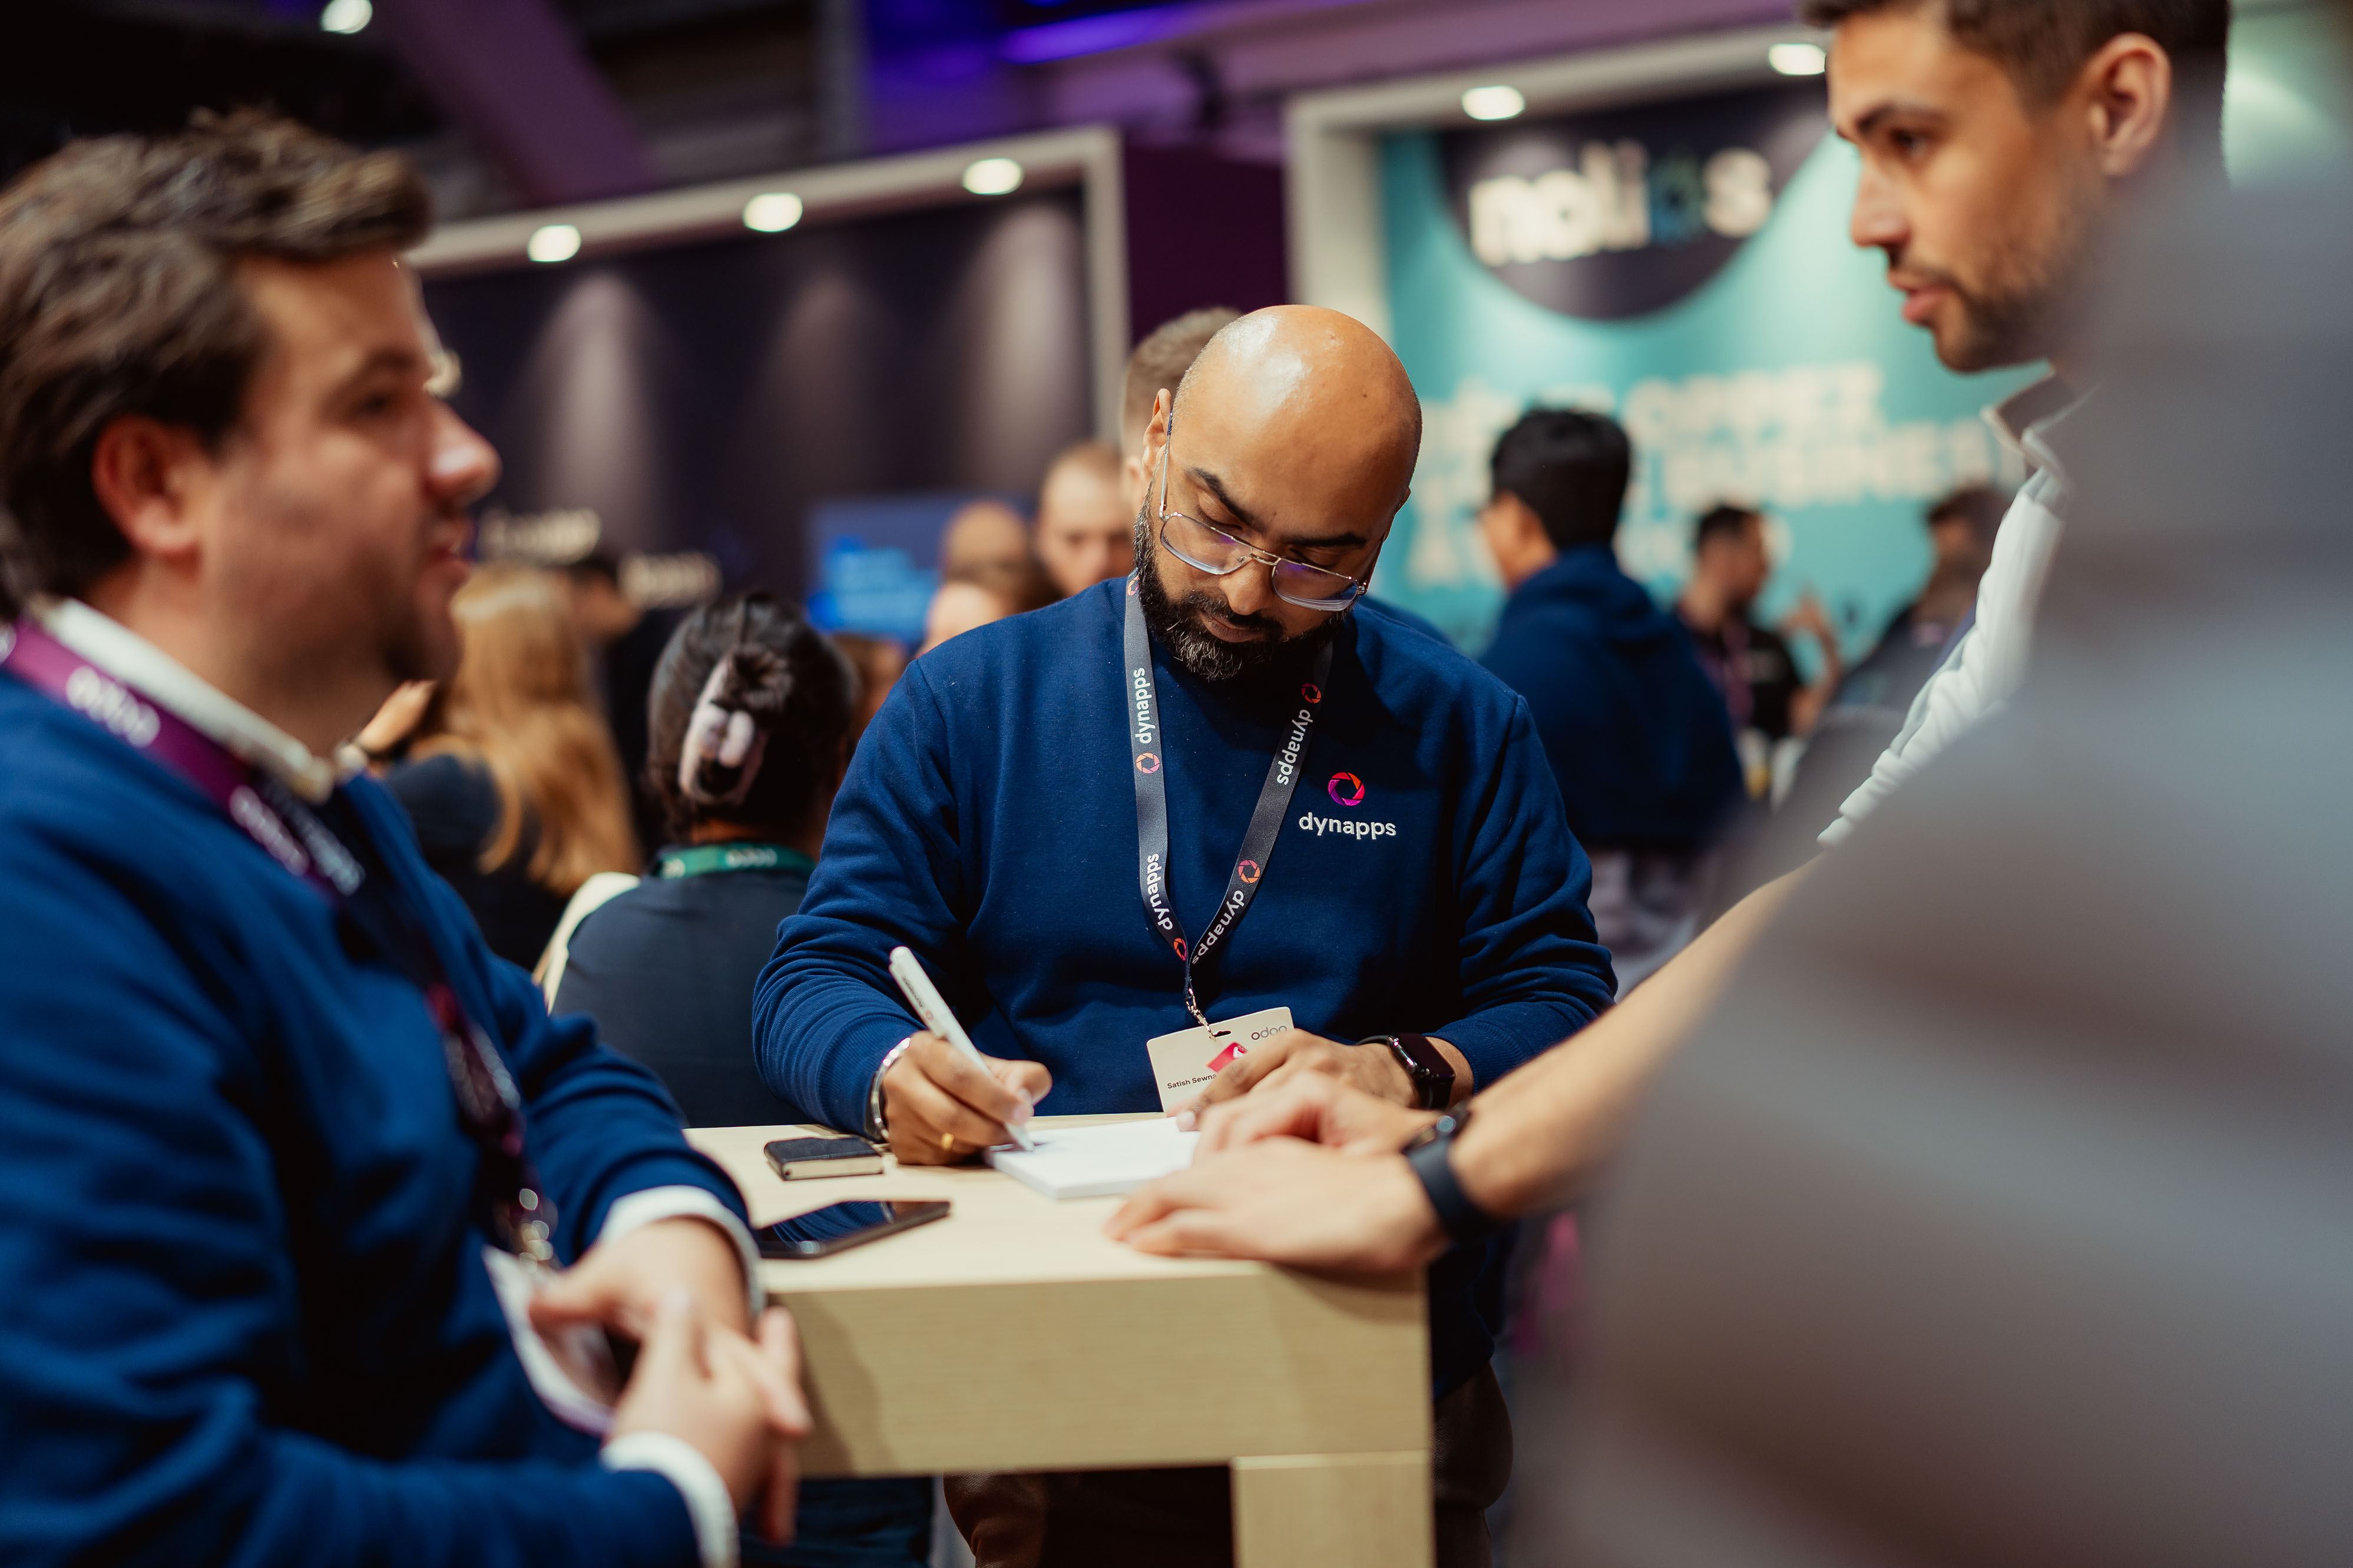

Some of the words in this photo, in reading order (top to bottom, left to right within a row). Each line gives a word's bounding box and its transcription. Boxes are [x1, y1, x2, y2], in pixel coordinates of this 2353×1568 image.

[1133, 668, 1156, 744] dynapps
[1276, 709, 1313, 785] dynapps
[1299, 812, 1396, 840] dynapps
[1147, 853, 1173, 930] dynapps
[1192, 890, 1245, 964] dynapps
[1167, 1079, 1191, 1089] Satish
